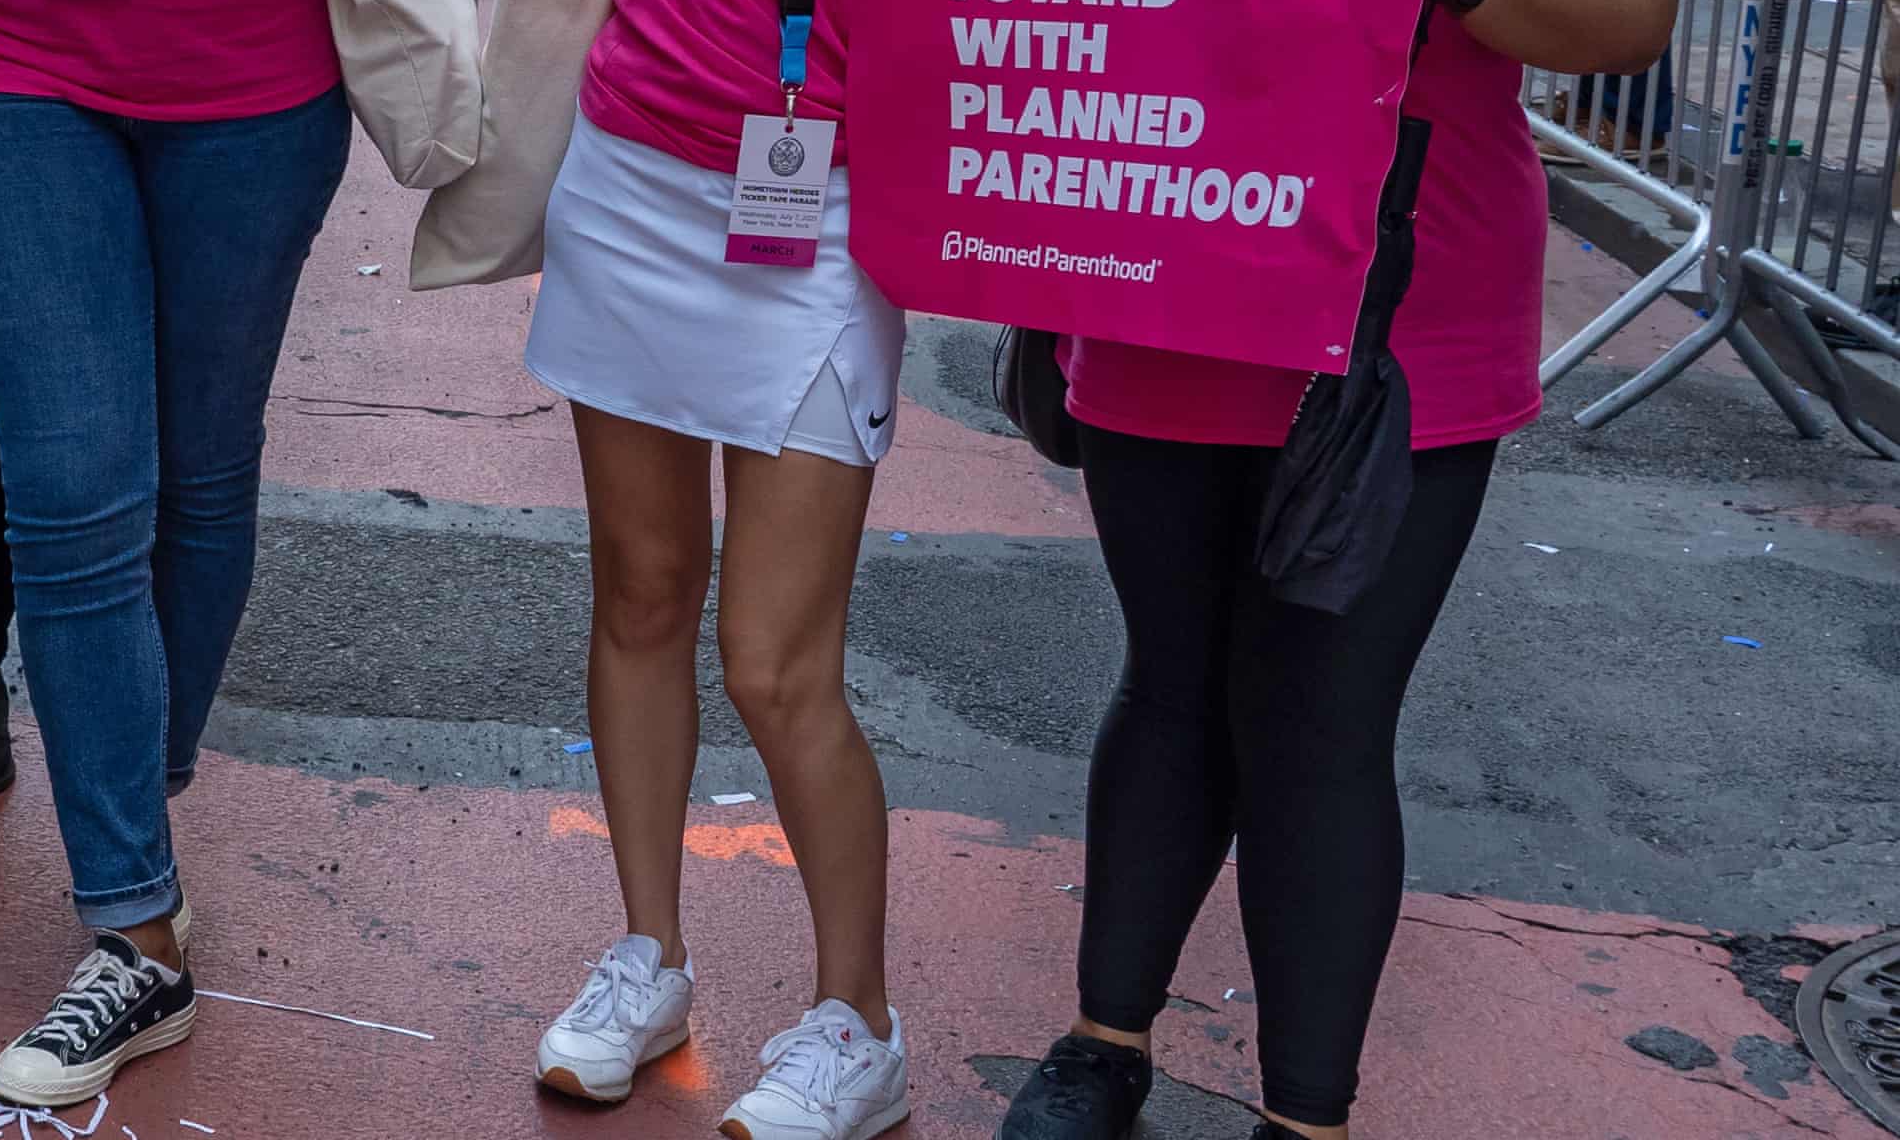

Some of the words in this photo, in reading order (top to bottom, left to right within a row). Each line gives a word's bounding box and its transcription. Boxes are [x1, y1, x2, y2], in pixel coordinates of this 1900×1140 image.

[950, 17, 1108, 73] WITH
[949, 82, 1204, 148] PLANNED
[947, 146, 1305, 228] PARENTHOOD
[750, 243, 794, 256] MARCH
[964, 237, 1041, 267] Planned
[1044, 247, 1156, 282] Parenthood
